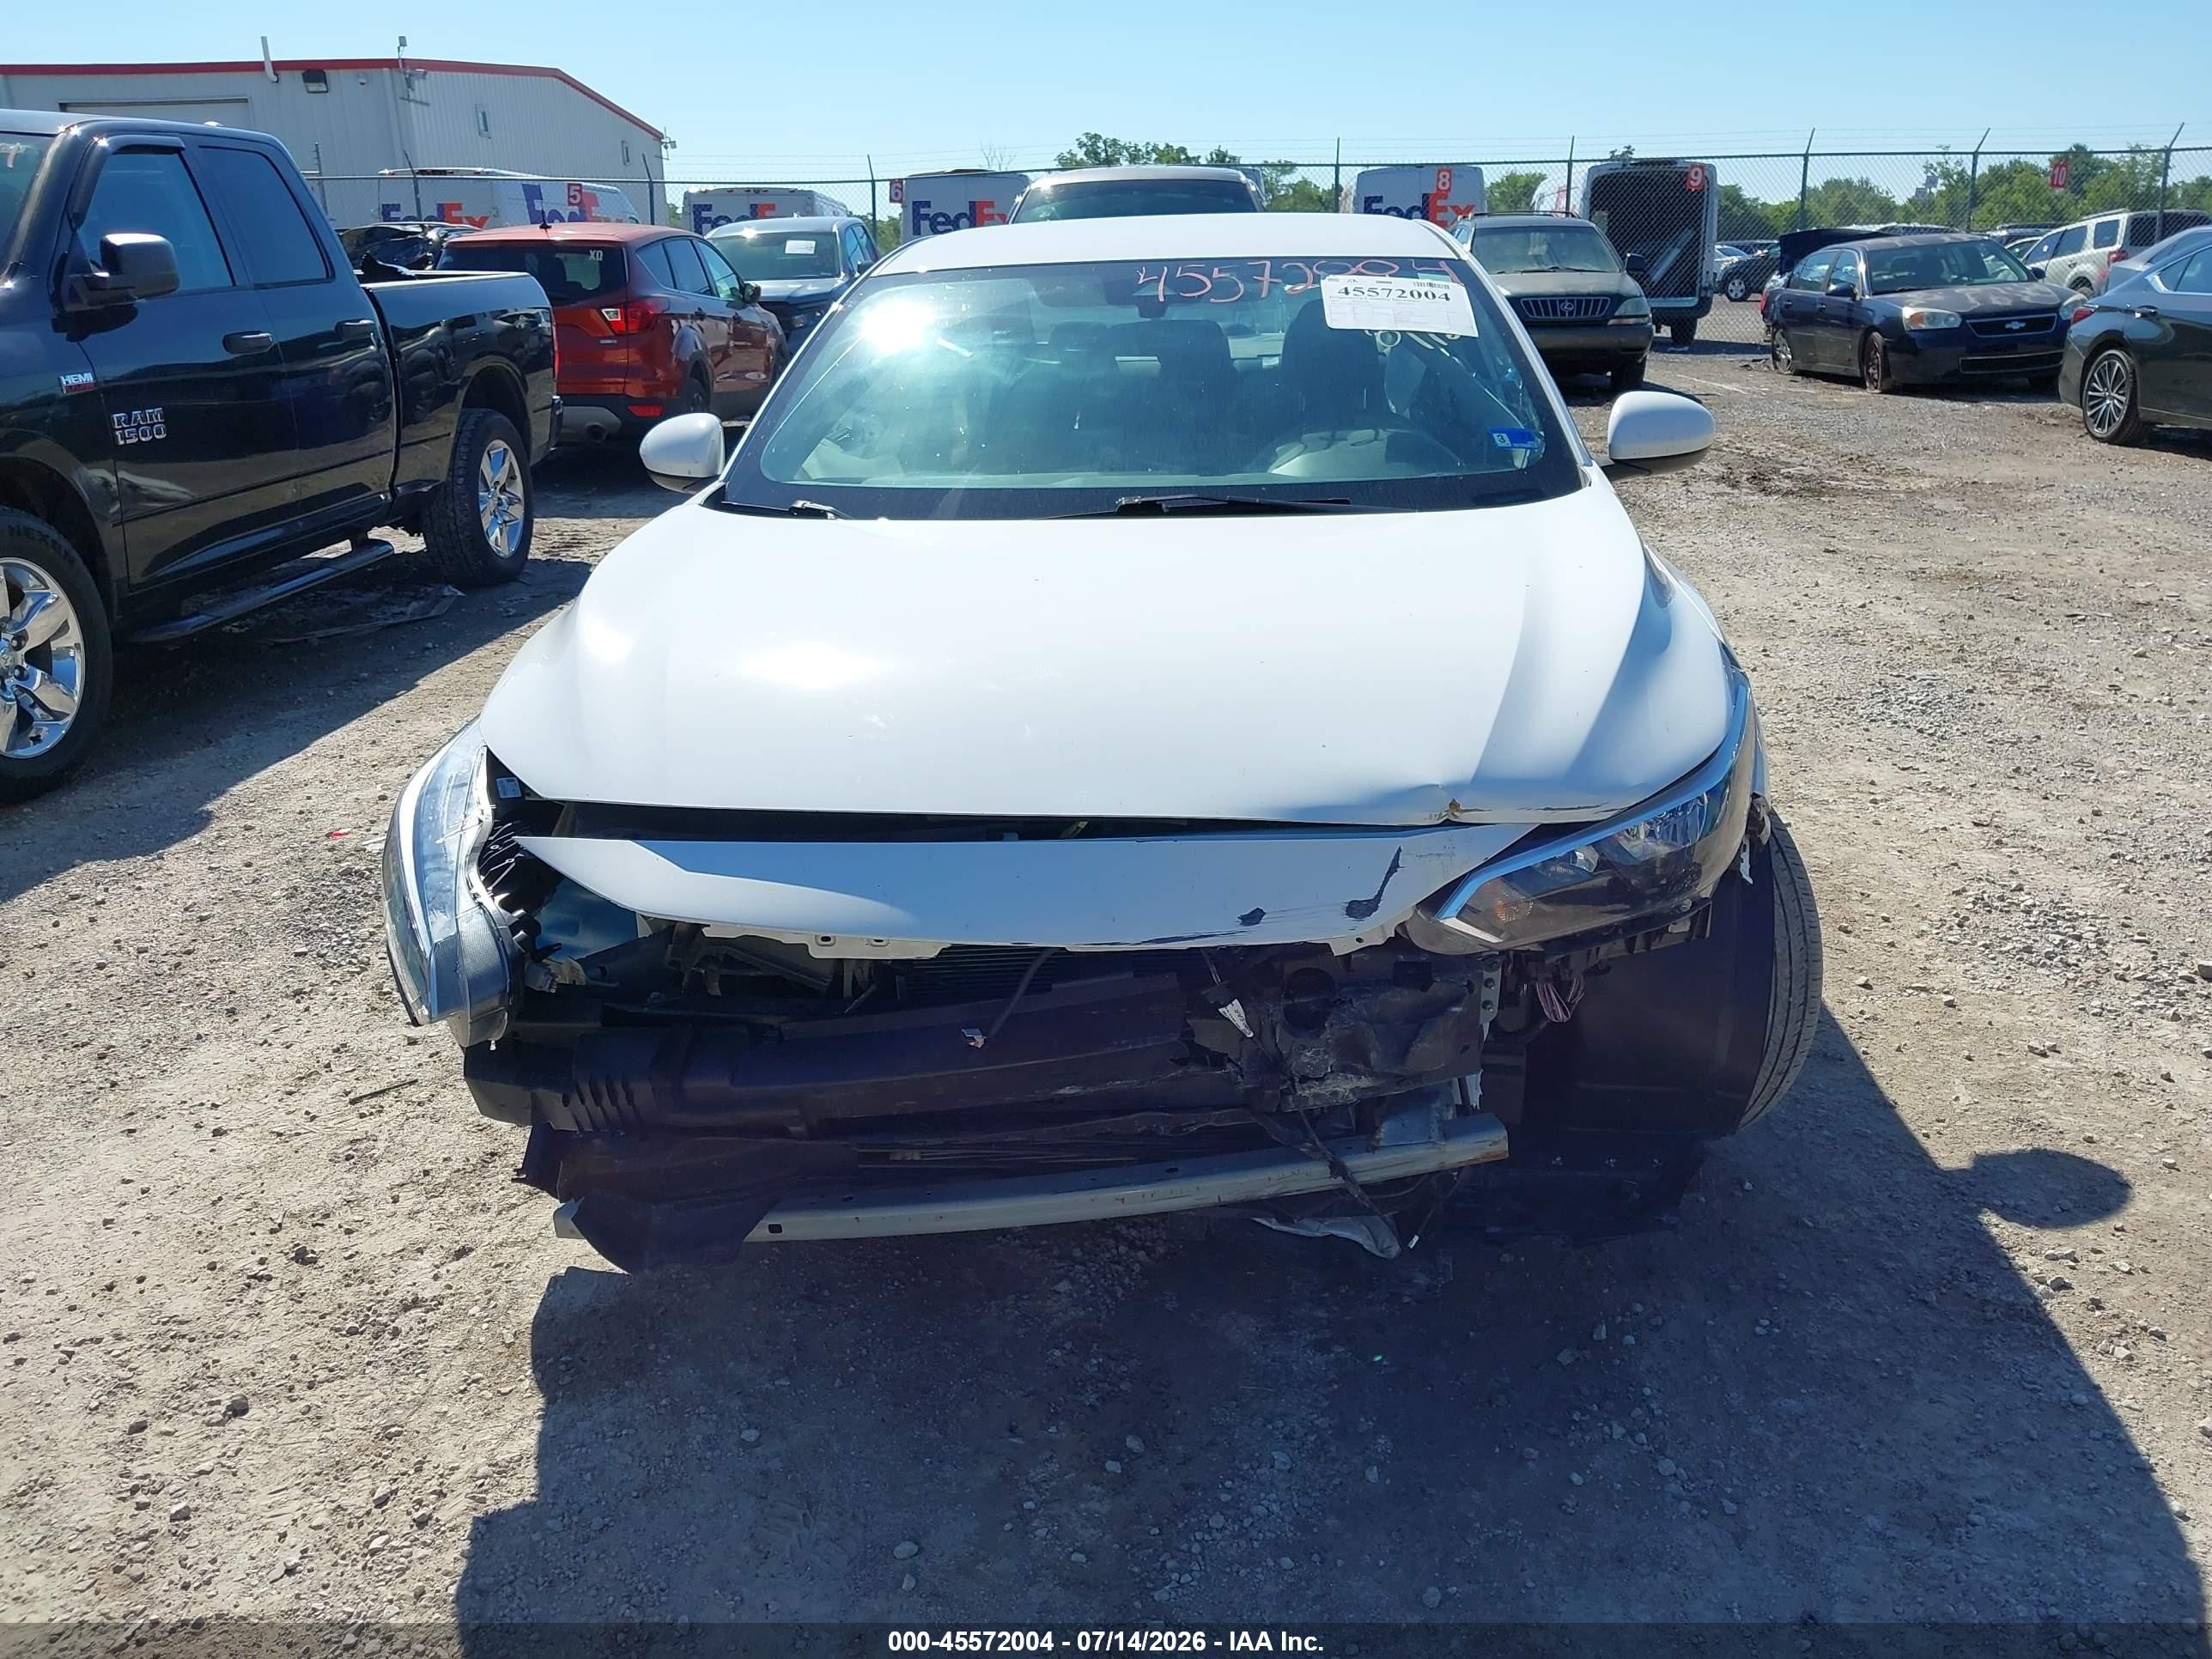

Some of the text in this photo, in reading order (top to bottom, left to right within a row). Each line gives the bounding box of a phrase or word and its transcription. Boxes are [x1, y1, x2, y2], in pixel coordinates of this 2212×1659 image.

[1438, 171, 1450, 190] 8
[1690, 167, 1703, 186] 9
[2053, 167, 2067, 185] 10
[569, 185, 581, 204] 5
[890, 183, 902, 201] 6
[1338, 286, 1451, 302] 45572004
[59, 372, 94, 386] HEMI
[112, 407, 165, 428] RAM
[116, 423, 167, 446] 1500
[1497, 434, 1506, 443] 3
